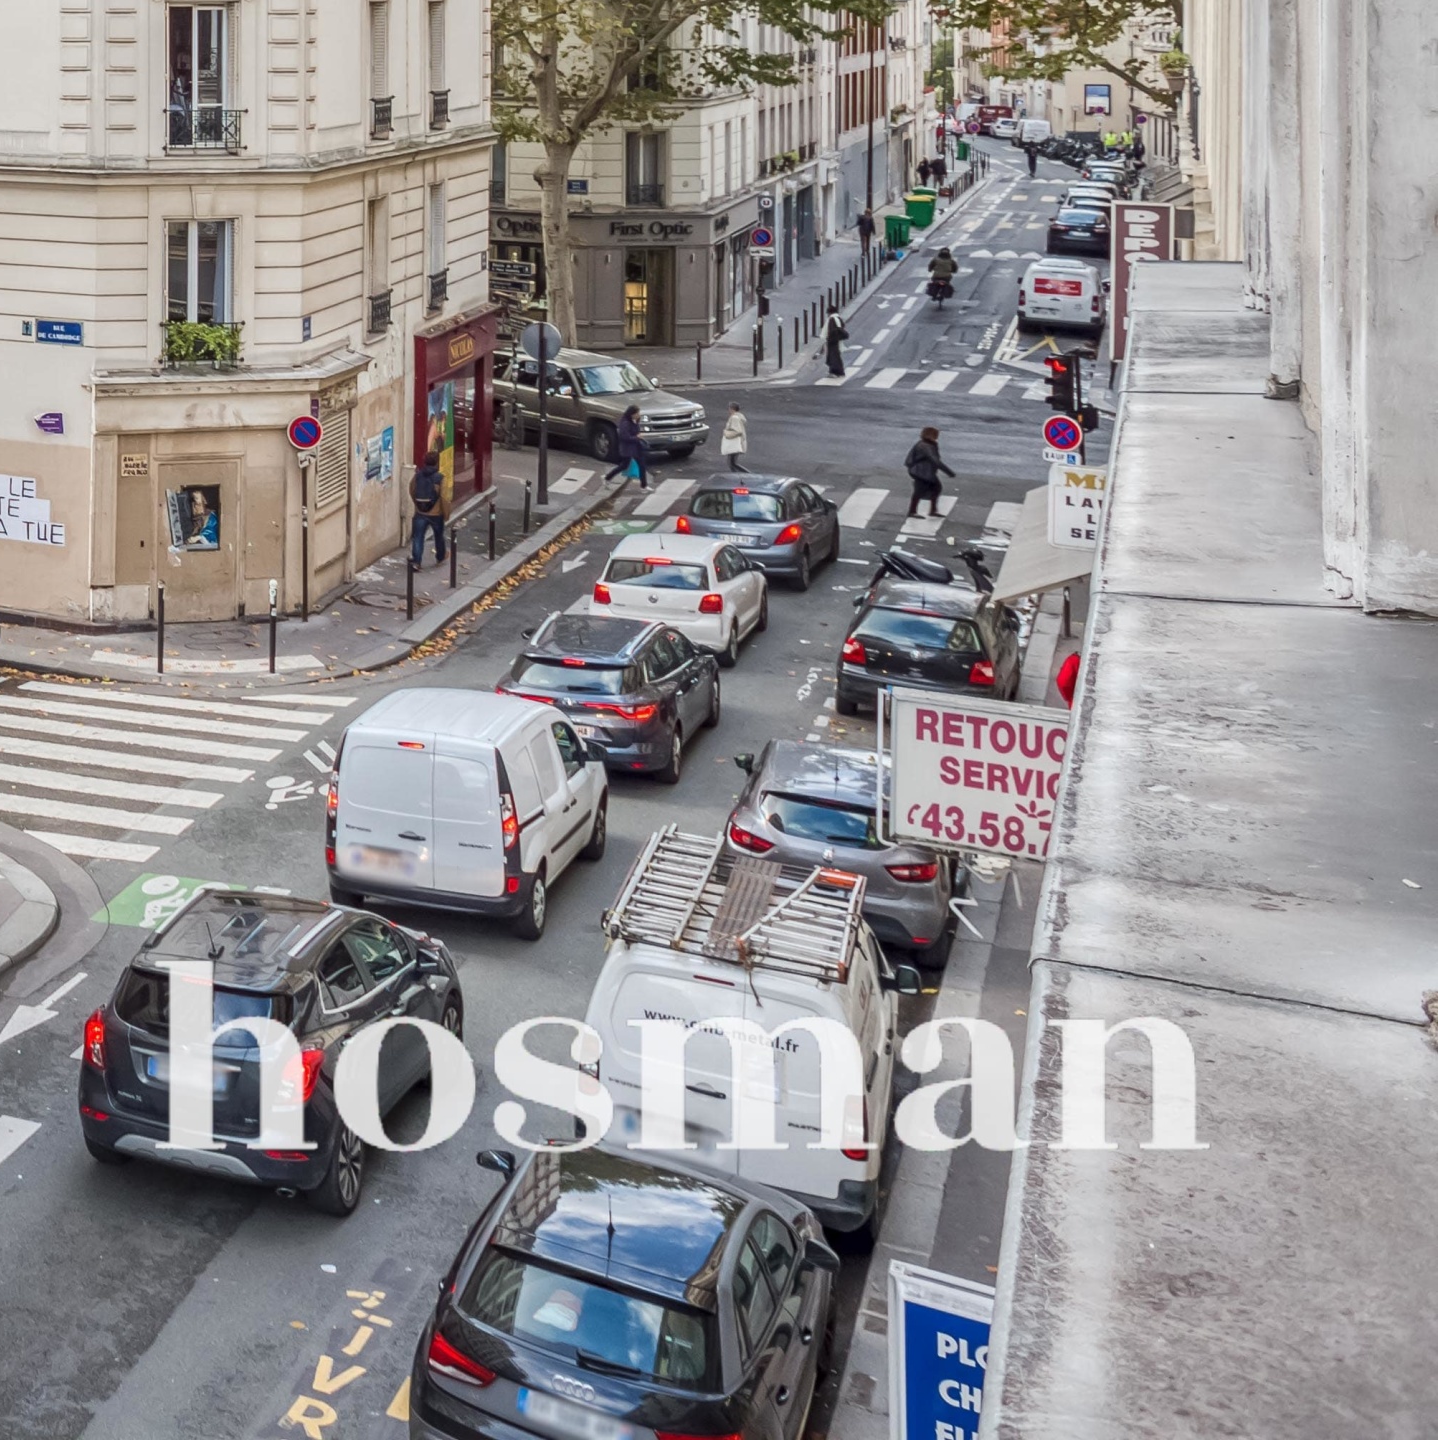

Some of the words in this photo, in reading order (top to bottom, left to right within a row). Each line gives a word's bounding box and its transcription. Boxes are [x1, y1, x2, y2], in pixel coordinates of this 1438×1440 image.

[609, 221, 644, 236] First
[649, 220, 694, 239] Optic
[9, 477, 35, 498] LE
[22, 521, 64, 545] TUE
